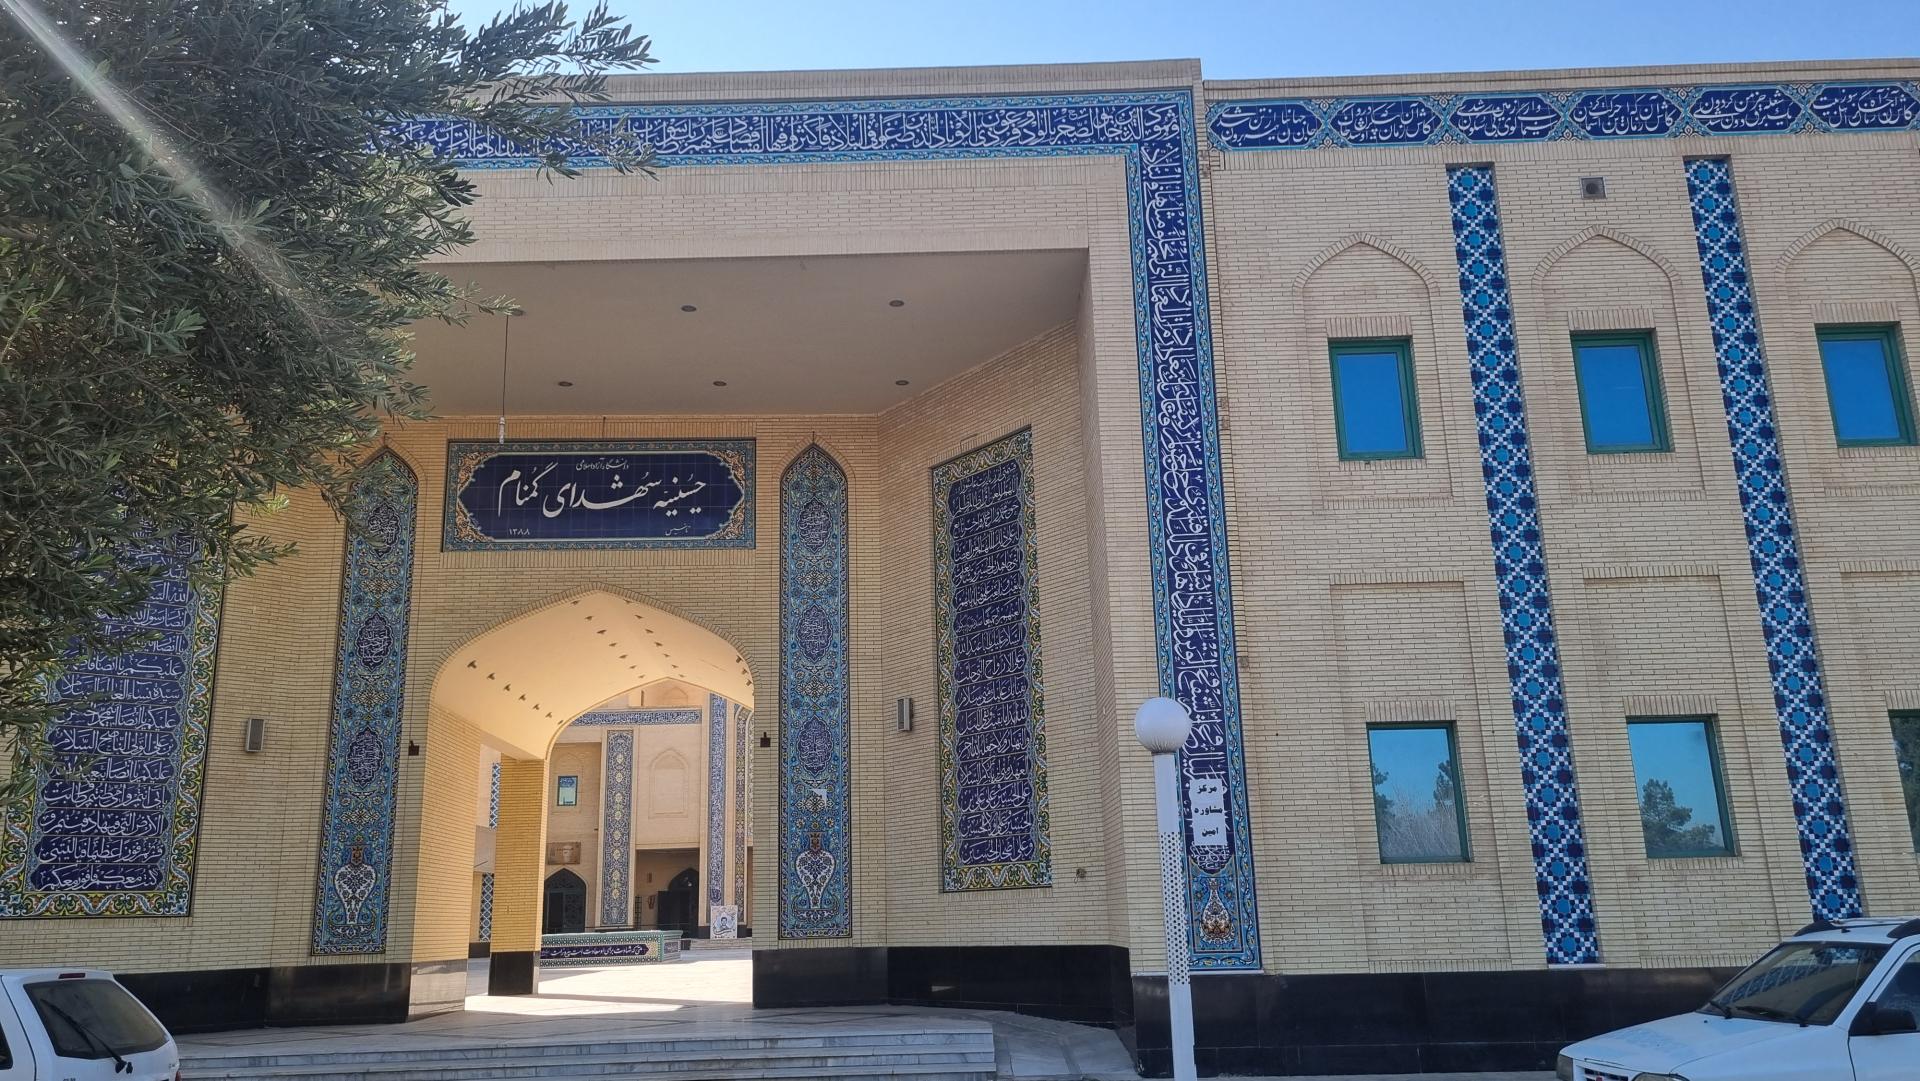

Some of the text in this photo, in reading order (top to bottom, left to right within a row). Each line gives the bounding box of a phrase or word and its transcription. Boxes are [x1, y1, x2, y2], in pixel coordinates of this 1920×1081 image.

[1381, 103, 1396, 117] که
[1588, 94, 1621, 118] حرکت
[1589, 94, 1604, 111] کرد
[1630, 94, 1647, 116] که
[1640, 95, 1659, 121] آن
[1700, 92, 1739, 115] گردون
[1733, 91, 1766, 112] خرمن
[1763, 89, 1784, 110] شعله
[1887, 94, 1916, 124] کاش
[1217, 106, 1257, 128] شدی
[1248, 108, 1267, 131] تن
[1264, 109, 1276, 129] از
[1338, 103, 1356, 137] خاک
[1400, 102, 1419, 125] آن
[1406, 108, 1435, 138] کاش
[1645, 101, 1677, 132] کاش
[1720, 113, 1745, 130] دون
[1745, 104, 1768, 127] برق
[1767, 102, 1793, 125] یک
[1848, 103, 1875, 127] زمان
[1221, 127, 1244, 147] برون
[1243, 124, 1280, 141] همه
[1293, 123, 1317, 143] جان
[1360, 130, 1368, 142] او
[1378, 123, 1405, 140] زمان
[1615, 117, 1644, 135] زمان
[498, 462, 558, 518] گمنام
[543, 471, 662, 518] شهدای
[1197, 784, 1218, 794] مرکز
[1194, 804, 1223, 816] مشاوره
[1201, 826, 1219, 837] امین
